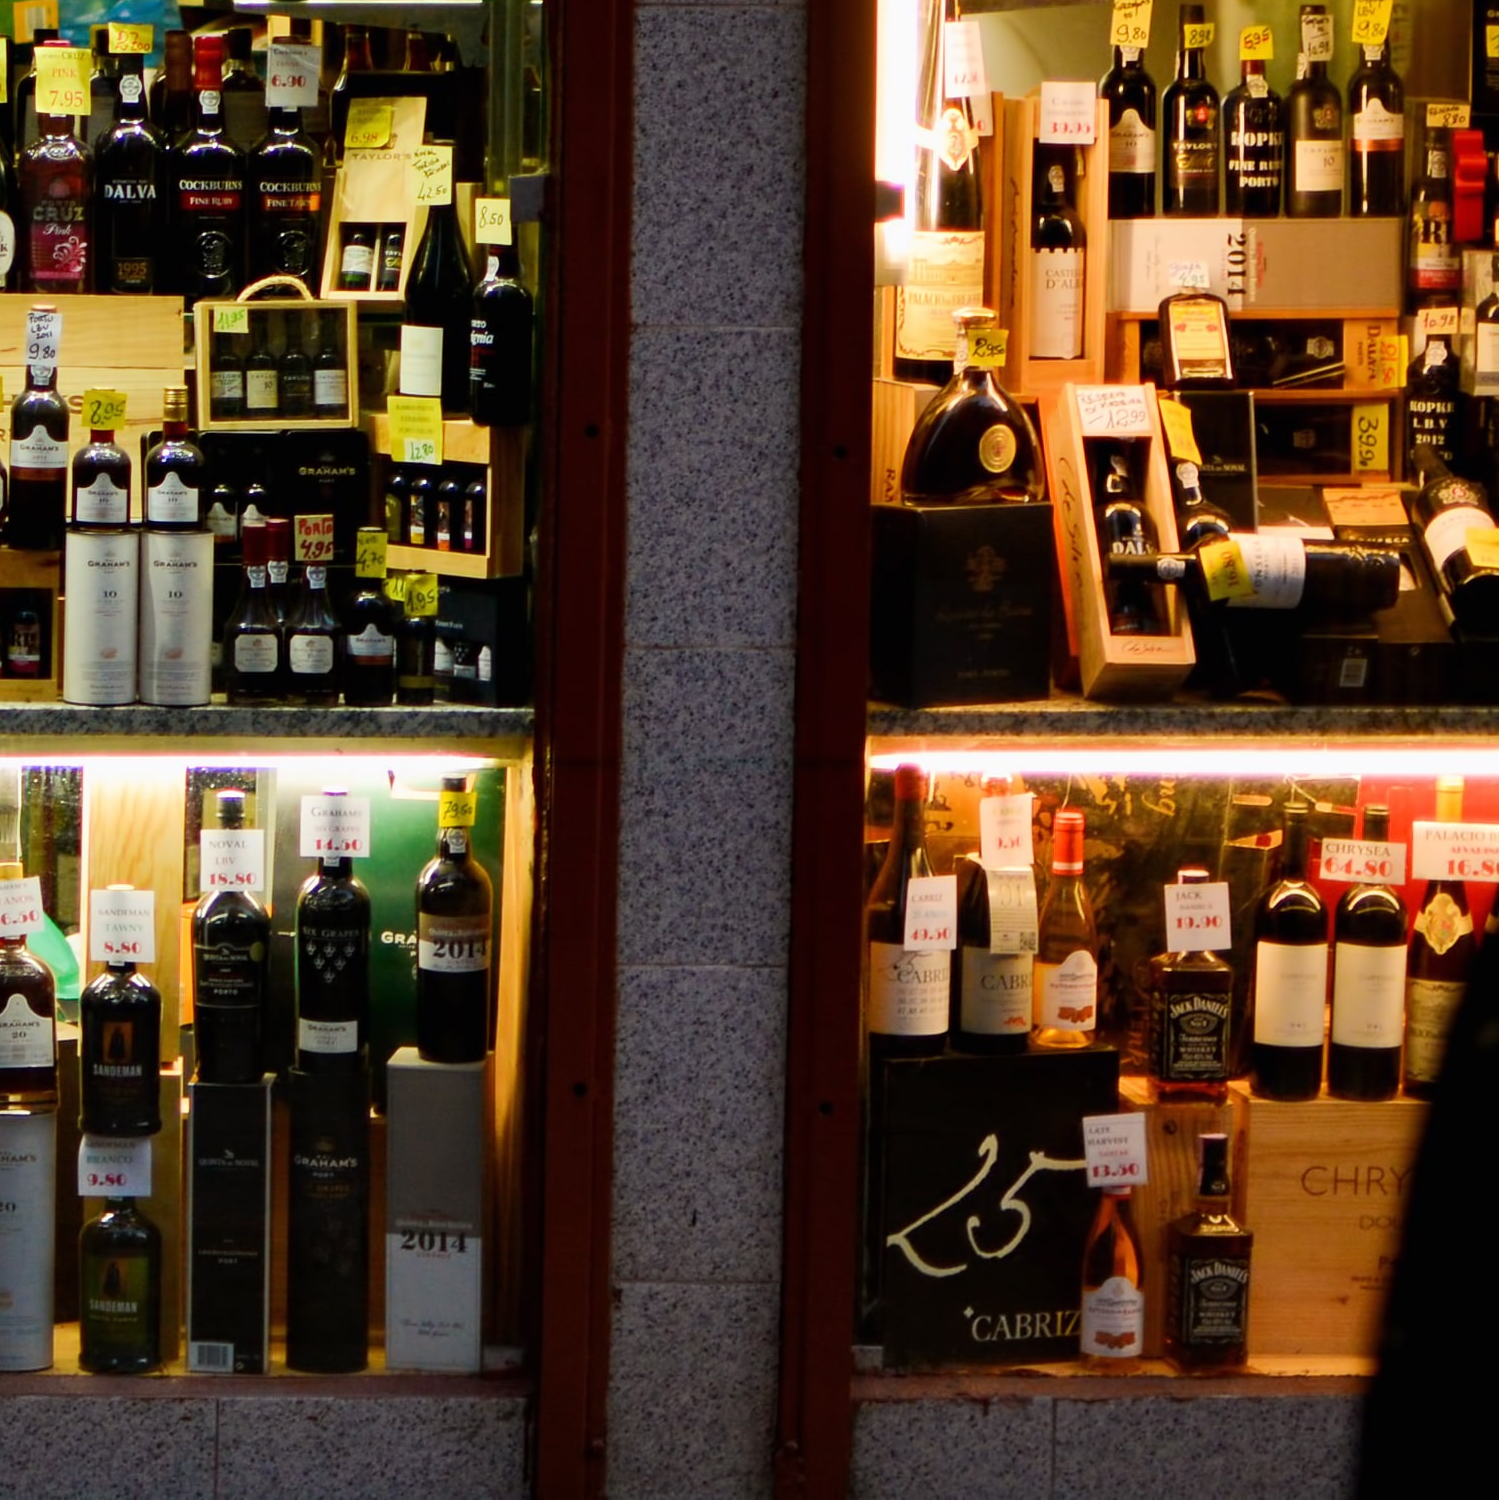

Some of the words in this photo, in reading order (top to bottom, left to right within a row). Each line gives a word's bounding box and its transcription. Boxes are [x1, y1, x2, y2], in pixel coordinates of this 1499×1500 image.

[1116, 24, 1147, 43] 9.80
[49, 91, 84, 107] 7.95
[351, 131, 379, 144] 6.98
[104, 184, 157, 199] DALVA
[33, 206, 84, 222] CRUZ
[1226, 232, 1247, 297] 2014
[1409, 401, 1455, 413] KOPKE
[1415, 434, 1445, 445] 2012
[299, 466, 356, 476] GRAHAM'S
[1425, 829, 1479, 843] PALACIO
[315, 838, 362, 852] 14.50
[1324, 844, 1392, 858] CHRYSEA
[1324, 858, 1394, 879] 64.80
[209, 872, 256, 886] 18.80
[1176, 892, 1202, 902] JACK
[1176, 913, 1223, 931] 19.90
[911, 926, 952, 943] 49.50
[104, 942, 141, 954] 8.80
[1170, 998, 1196, 1018] JACK
[1195, 996, 1230, 1018] DANIEL'S
[93, 1064, 142, 1077] SANDEMAN
[86, 1153, 133, 1165] BRANCO
[294, 1153, 358, 1170] GRAHAM'S
[1091, 1162, 1141, 1179] 13.50
[87, 1173, 128, 1187] 9.80
[400, 1230, 468, 1254] 2014
[89, 1300, 138, 1314] SANDEMAN
[971, 1311, 1082, 1342] CABRIZ
